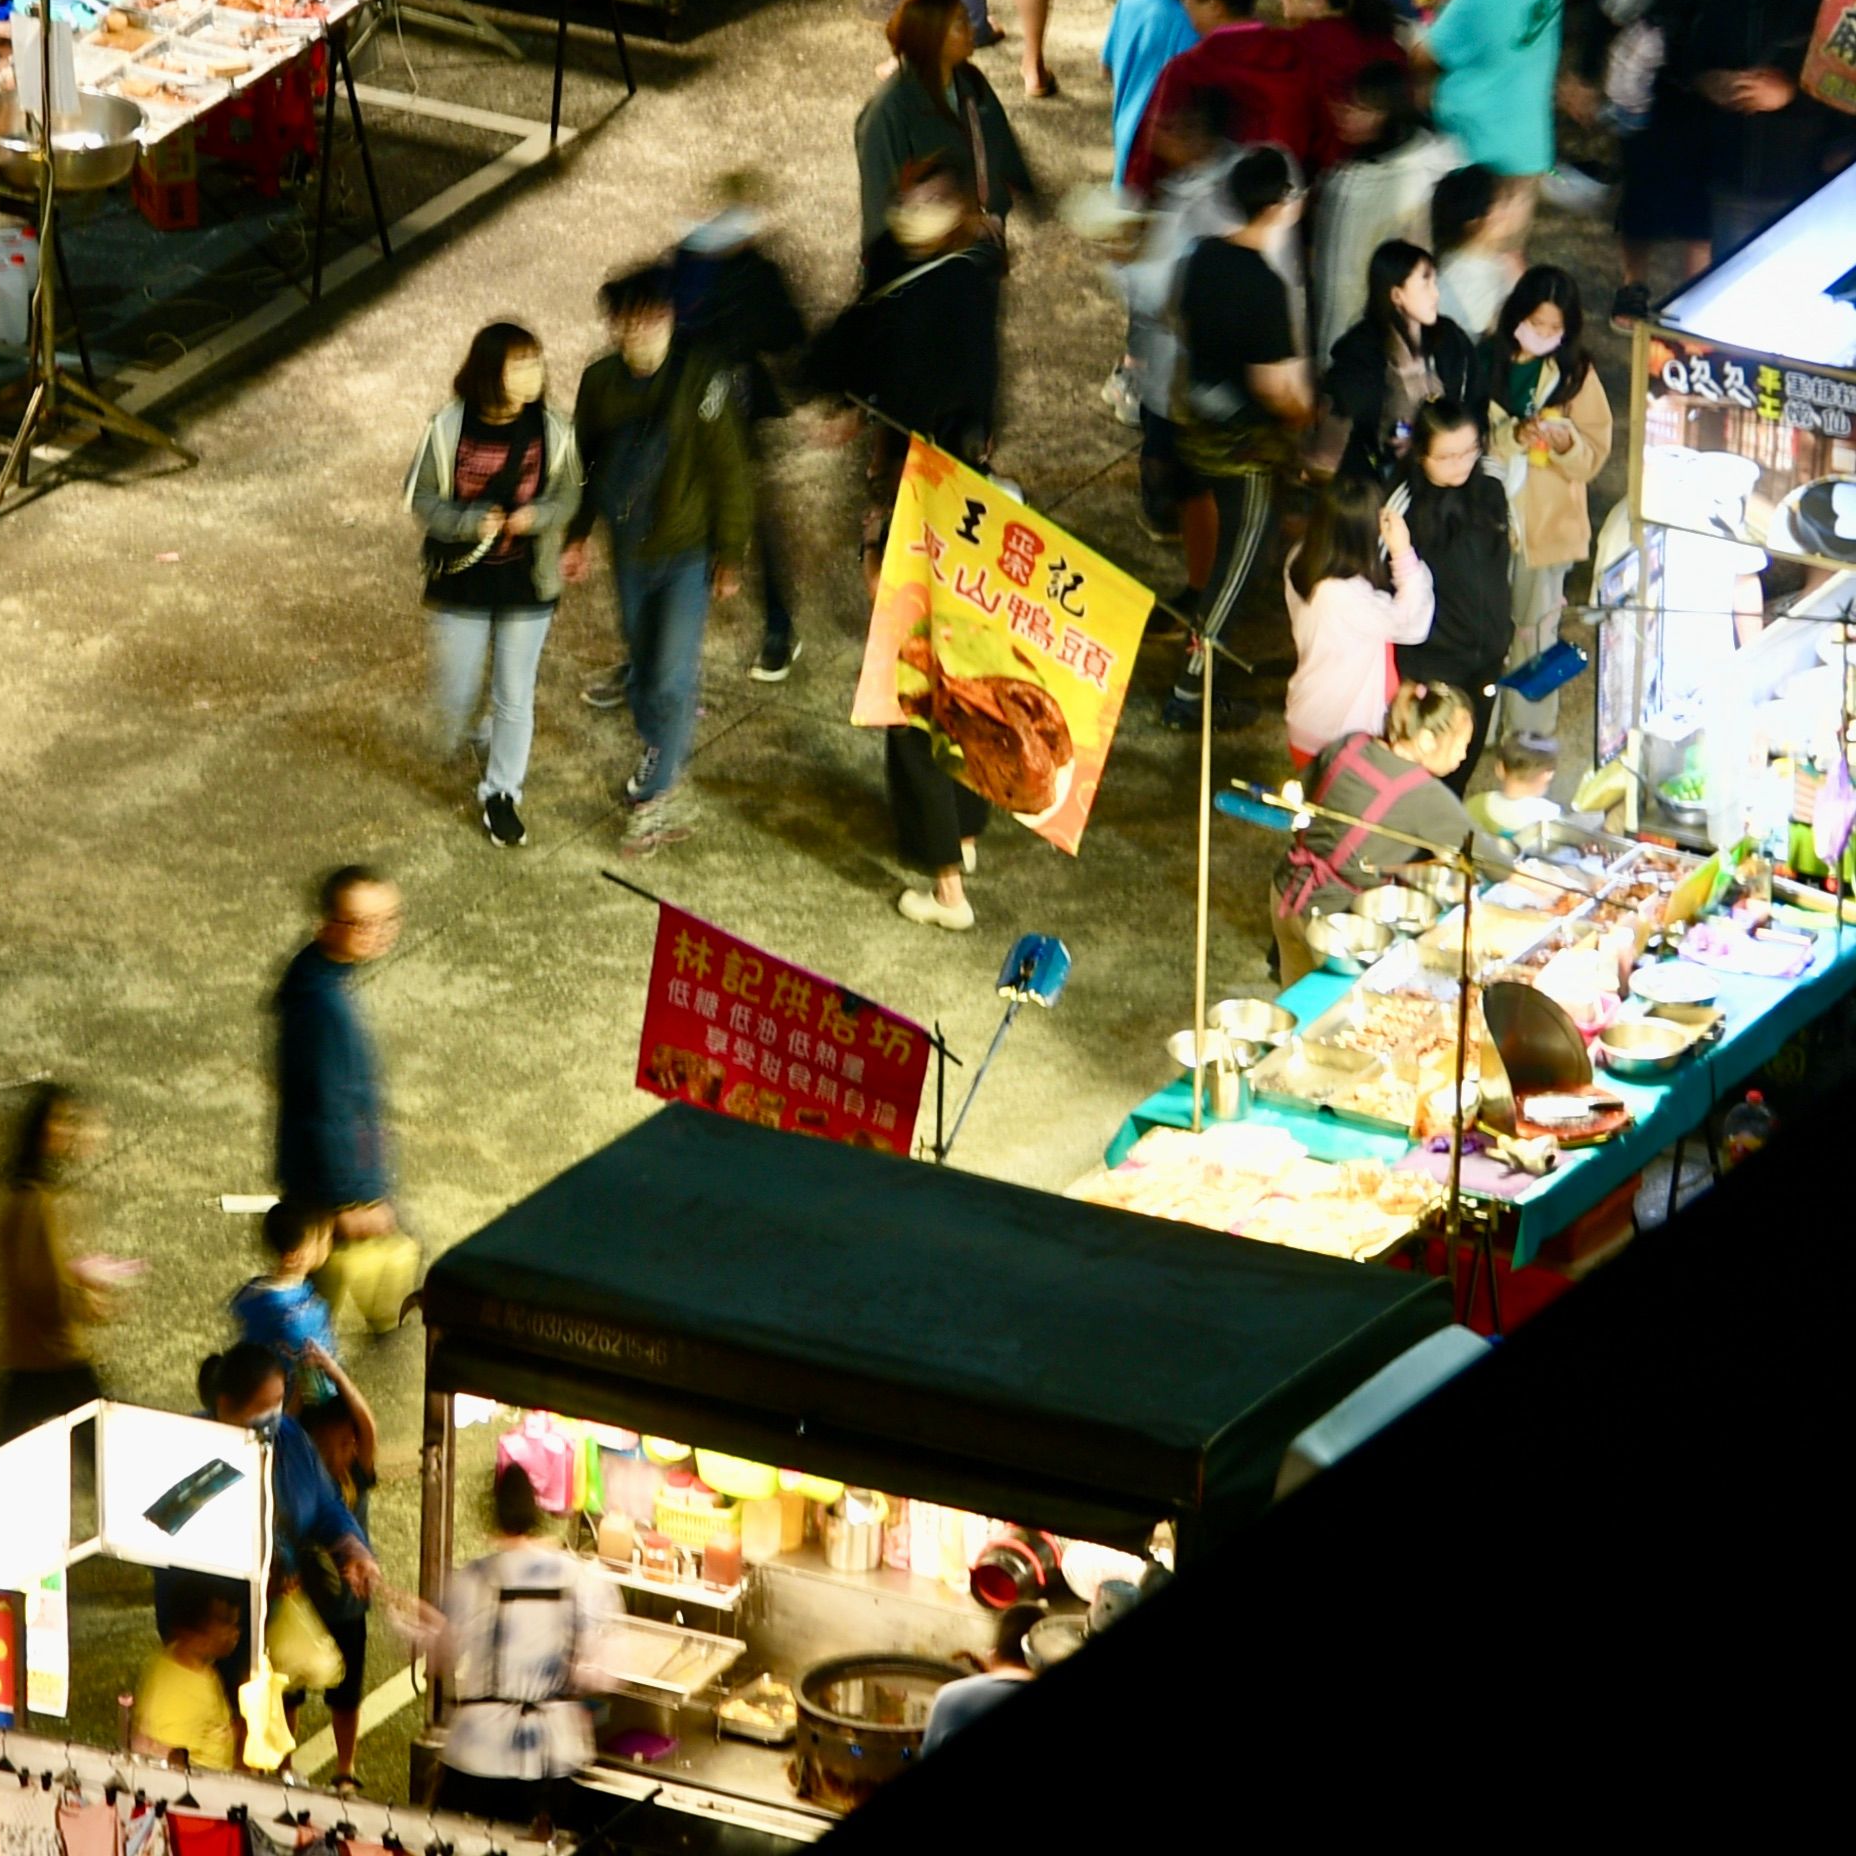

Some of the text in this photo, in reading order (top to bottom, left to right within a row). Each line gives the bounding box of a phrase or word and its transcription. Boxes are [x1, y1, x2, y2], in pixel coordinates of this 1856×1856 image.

[667, 976, 865, 1084] 低糖 低油 低熱量
[671, 928, 916, 1067] 林記烘焙坊
[704, 1024, 898, 1131] 享受甜食無負擔
